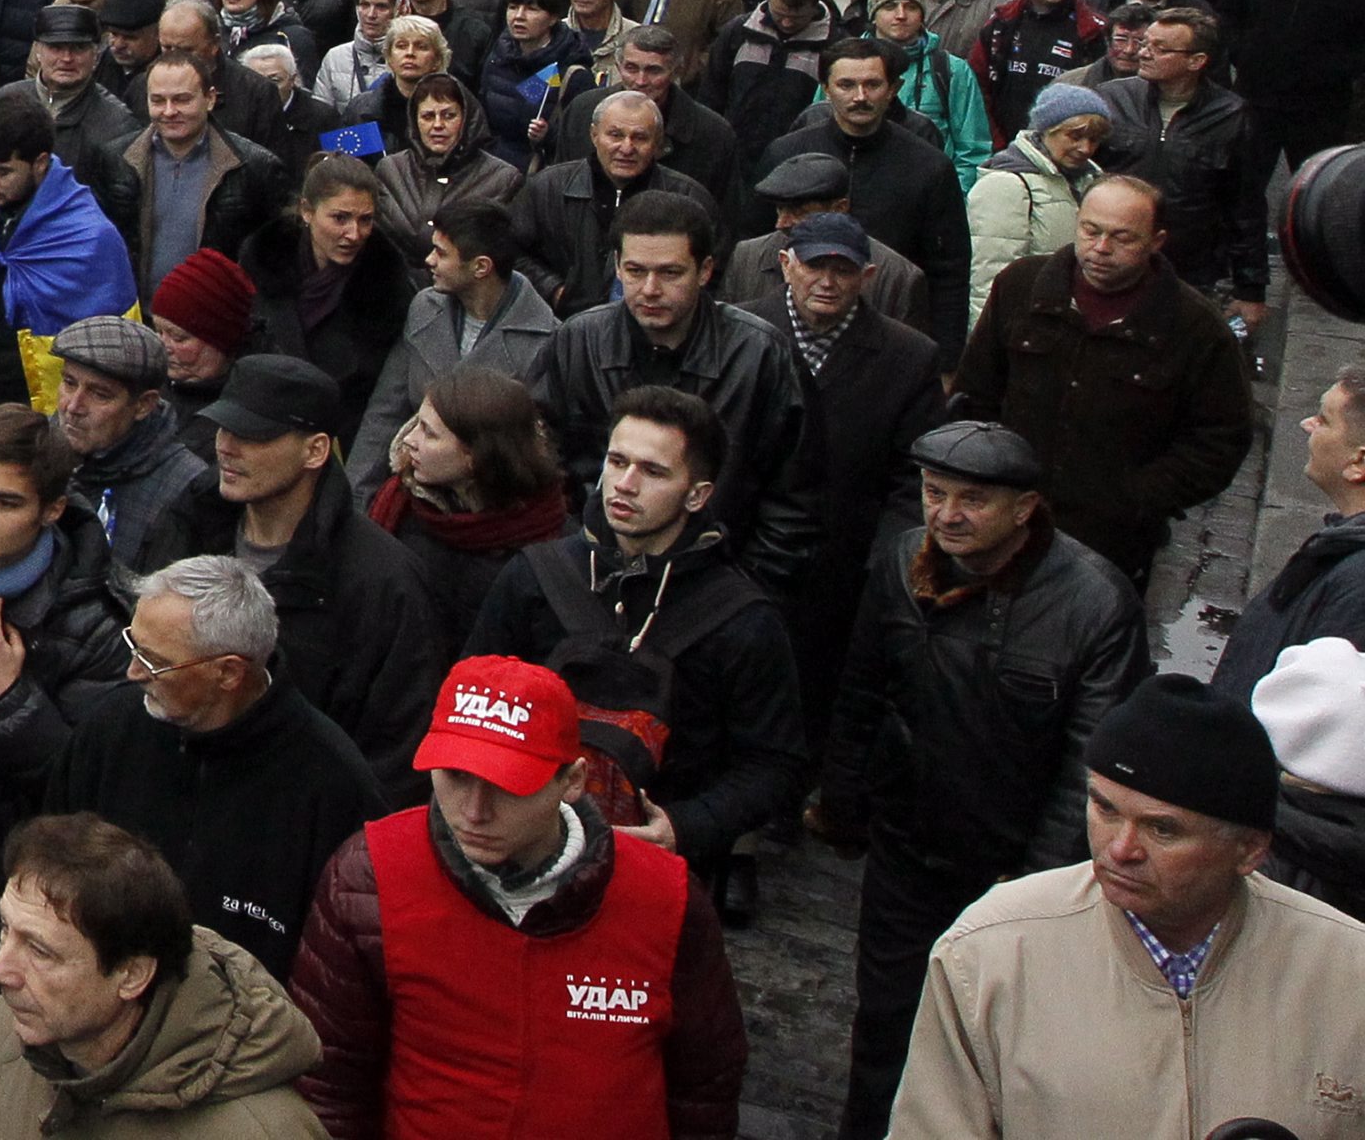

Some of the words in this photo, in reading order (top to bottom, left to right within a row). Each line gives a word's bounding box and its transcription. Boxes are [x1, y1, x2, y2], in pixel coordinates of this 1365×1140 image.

[453, 692, 530, 727] УДАР
[447, 715, 482, 727] ВІТАЛІЯ
[482, 720, 526, 741] КЛИЧКА
[566, 984, 649, 1011] УДАР
[566, 1010, 607, 1021] ВІТАЛІЯ
[609, 1014, 650, 1025] КЛИЧКА
